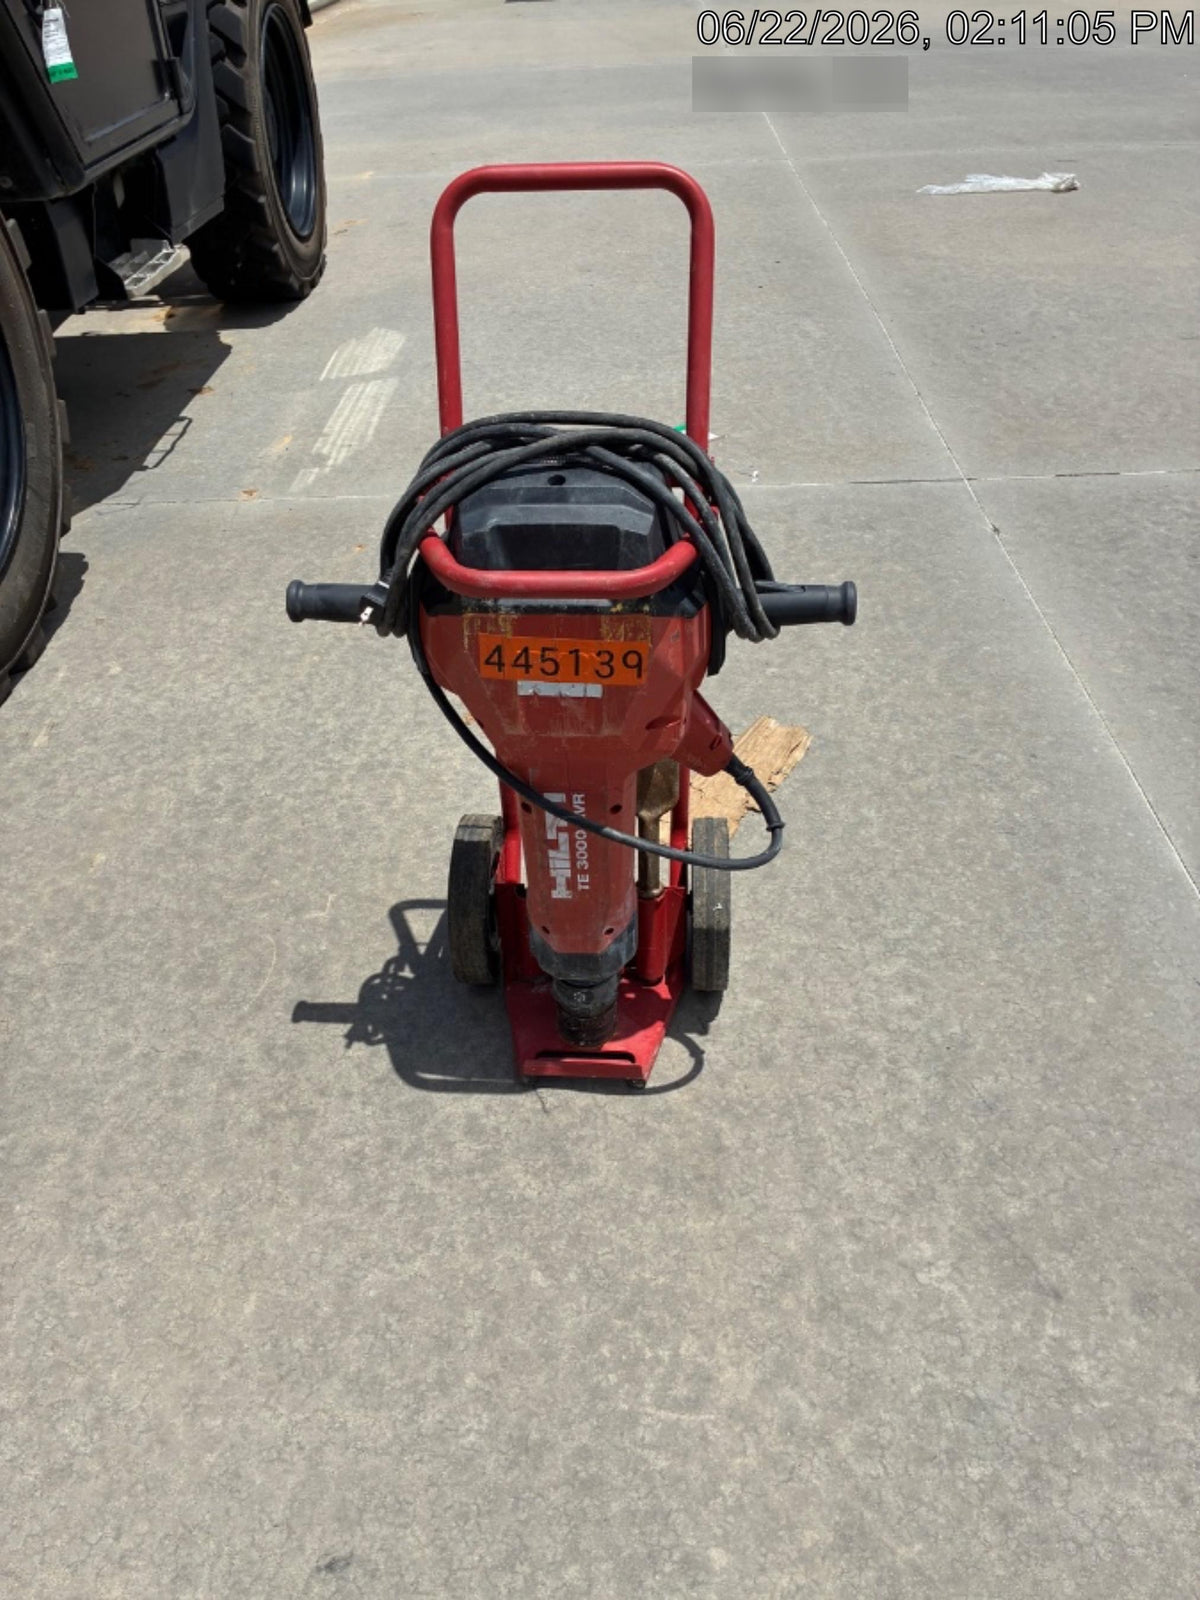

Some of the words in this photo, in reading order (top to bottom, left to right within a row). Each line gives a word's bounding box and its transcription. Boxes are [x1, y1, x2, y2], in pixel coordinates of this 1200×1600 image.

[483, 644, 644, 679] 445139
[543, 792, 573, 899] HILTI
[575, 829, 590, 870] 3000
[577, 873, 590, 890] TE
